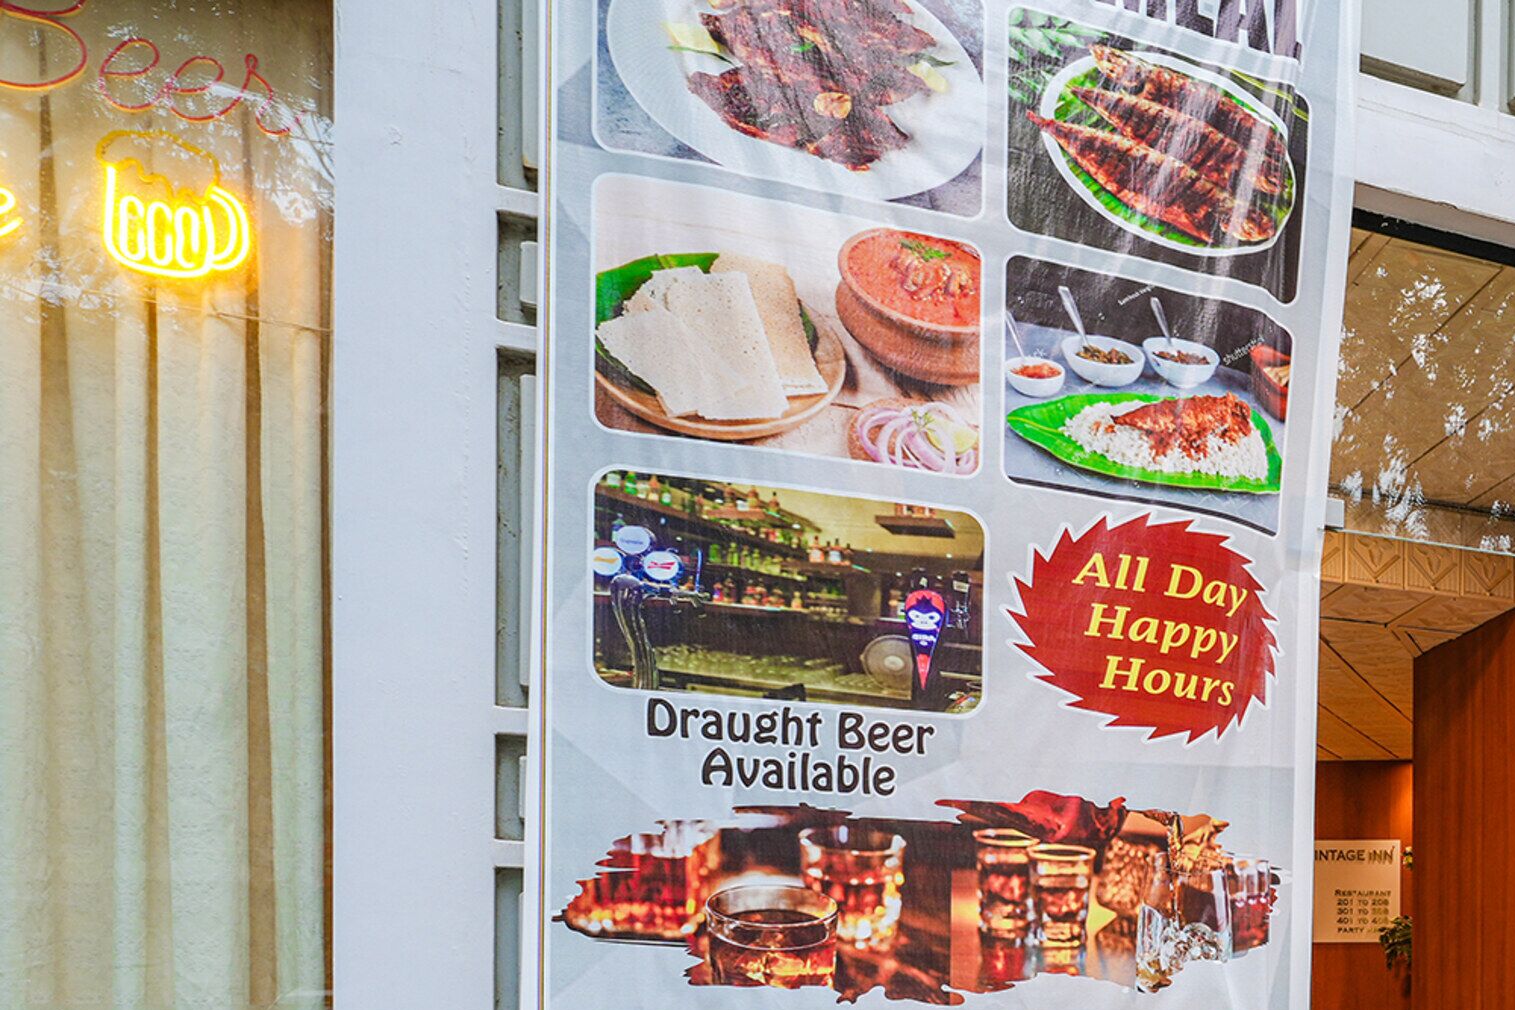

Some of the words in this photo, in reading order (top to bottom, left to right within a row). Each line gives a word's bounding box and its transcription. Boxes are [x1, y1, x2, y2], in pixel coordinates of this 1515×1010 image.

[1071, 552, 1150, 593] All
[1164, 563, 1248, 617] Day
[1084, 603, 1239, 664] Happy
[1098, 655, 1235, 706] Hours
[646, 697, 822, 748] Draught
[838, 711, 934, 754] Beer
[701, 746, 895, 796] Available
